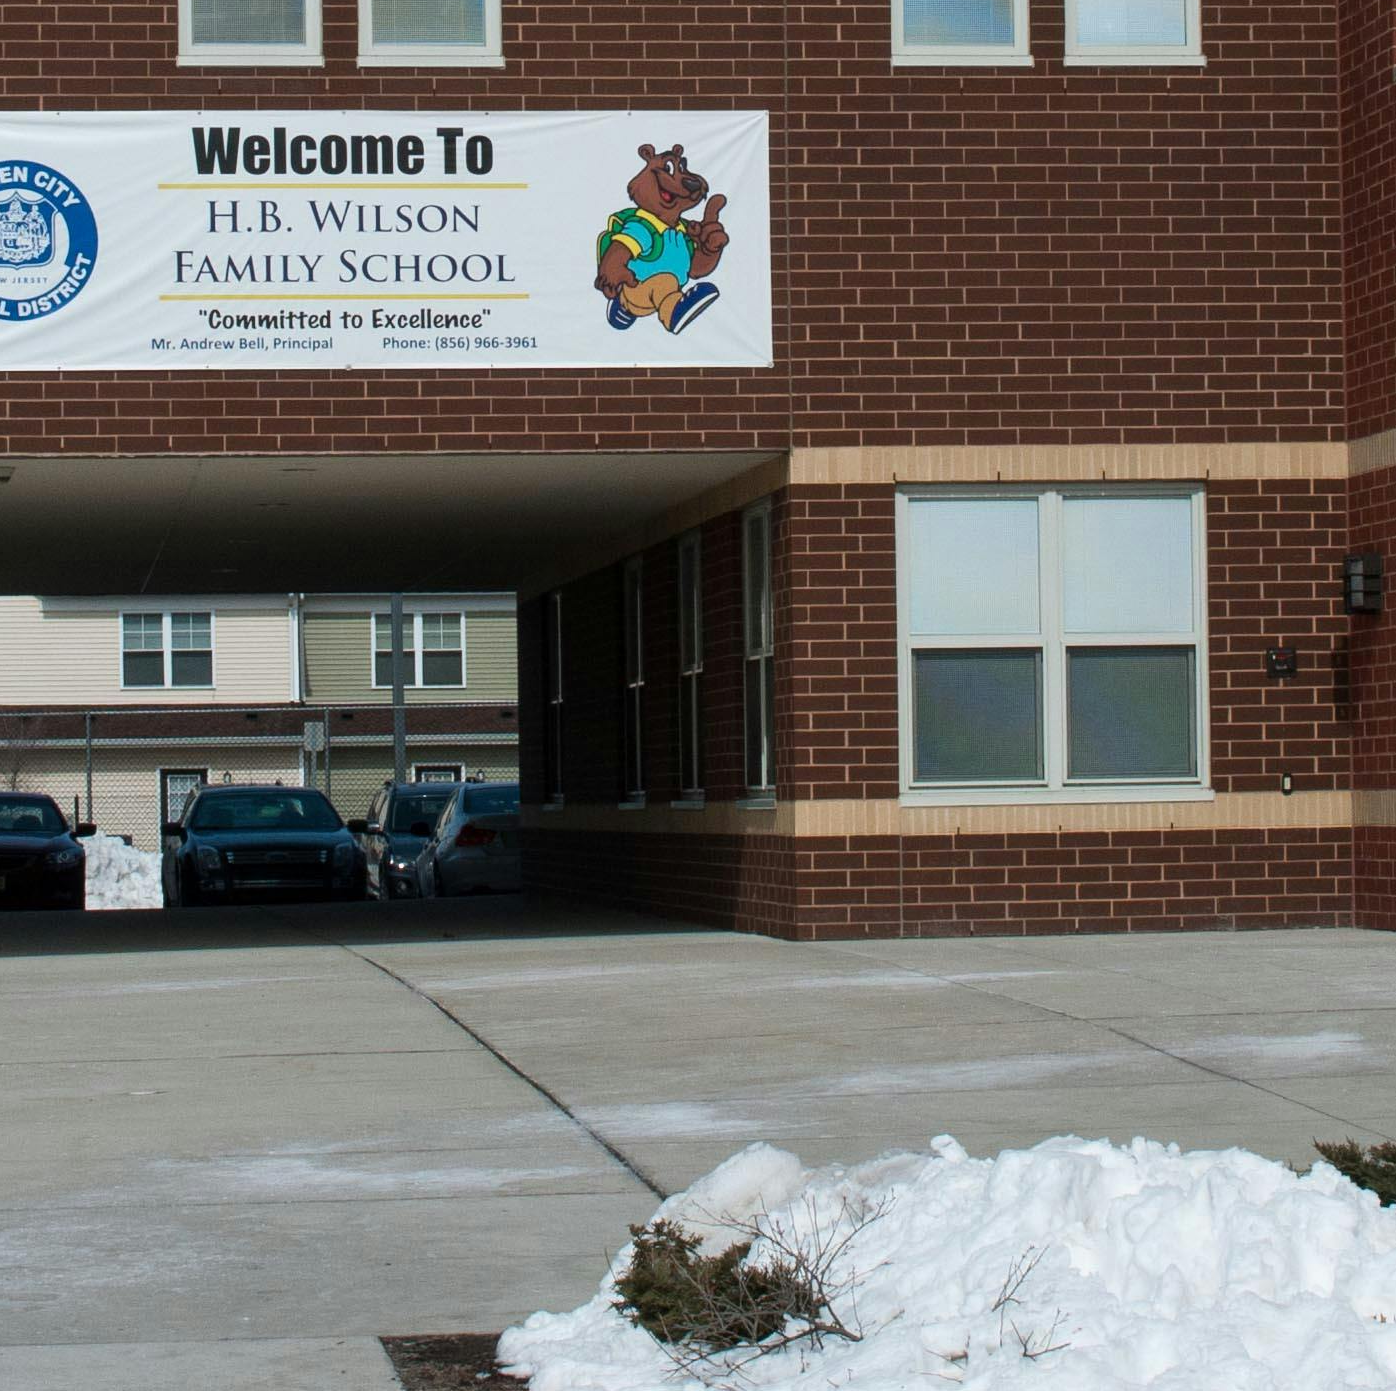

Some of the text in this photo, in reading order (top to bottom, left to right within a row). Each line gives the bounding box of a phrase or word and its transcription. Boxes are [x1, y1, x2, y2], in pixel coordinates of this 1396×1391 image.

[191, 126, 494, 177] Welcome To
[33, 170, 81, 209] CITY
[207, 200, 480, 234] H.B. WILSON
[11, 276, 49, 285] JERSEY
[174, 249, 517, 284] FAMILY SCHOOL
[17, 252, 92, 318] DISTRICT
[198, 308, 492, 331] "Committed to Excellence"
[151, 336, 333, 354] Mr. Andrew Bell, Principal
[382, 336, 539, 352] Phone: (856) 966-3961
